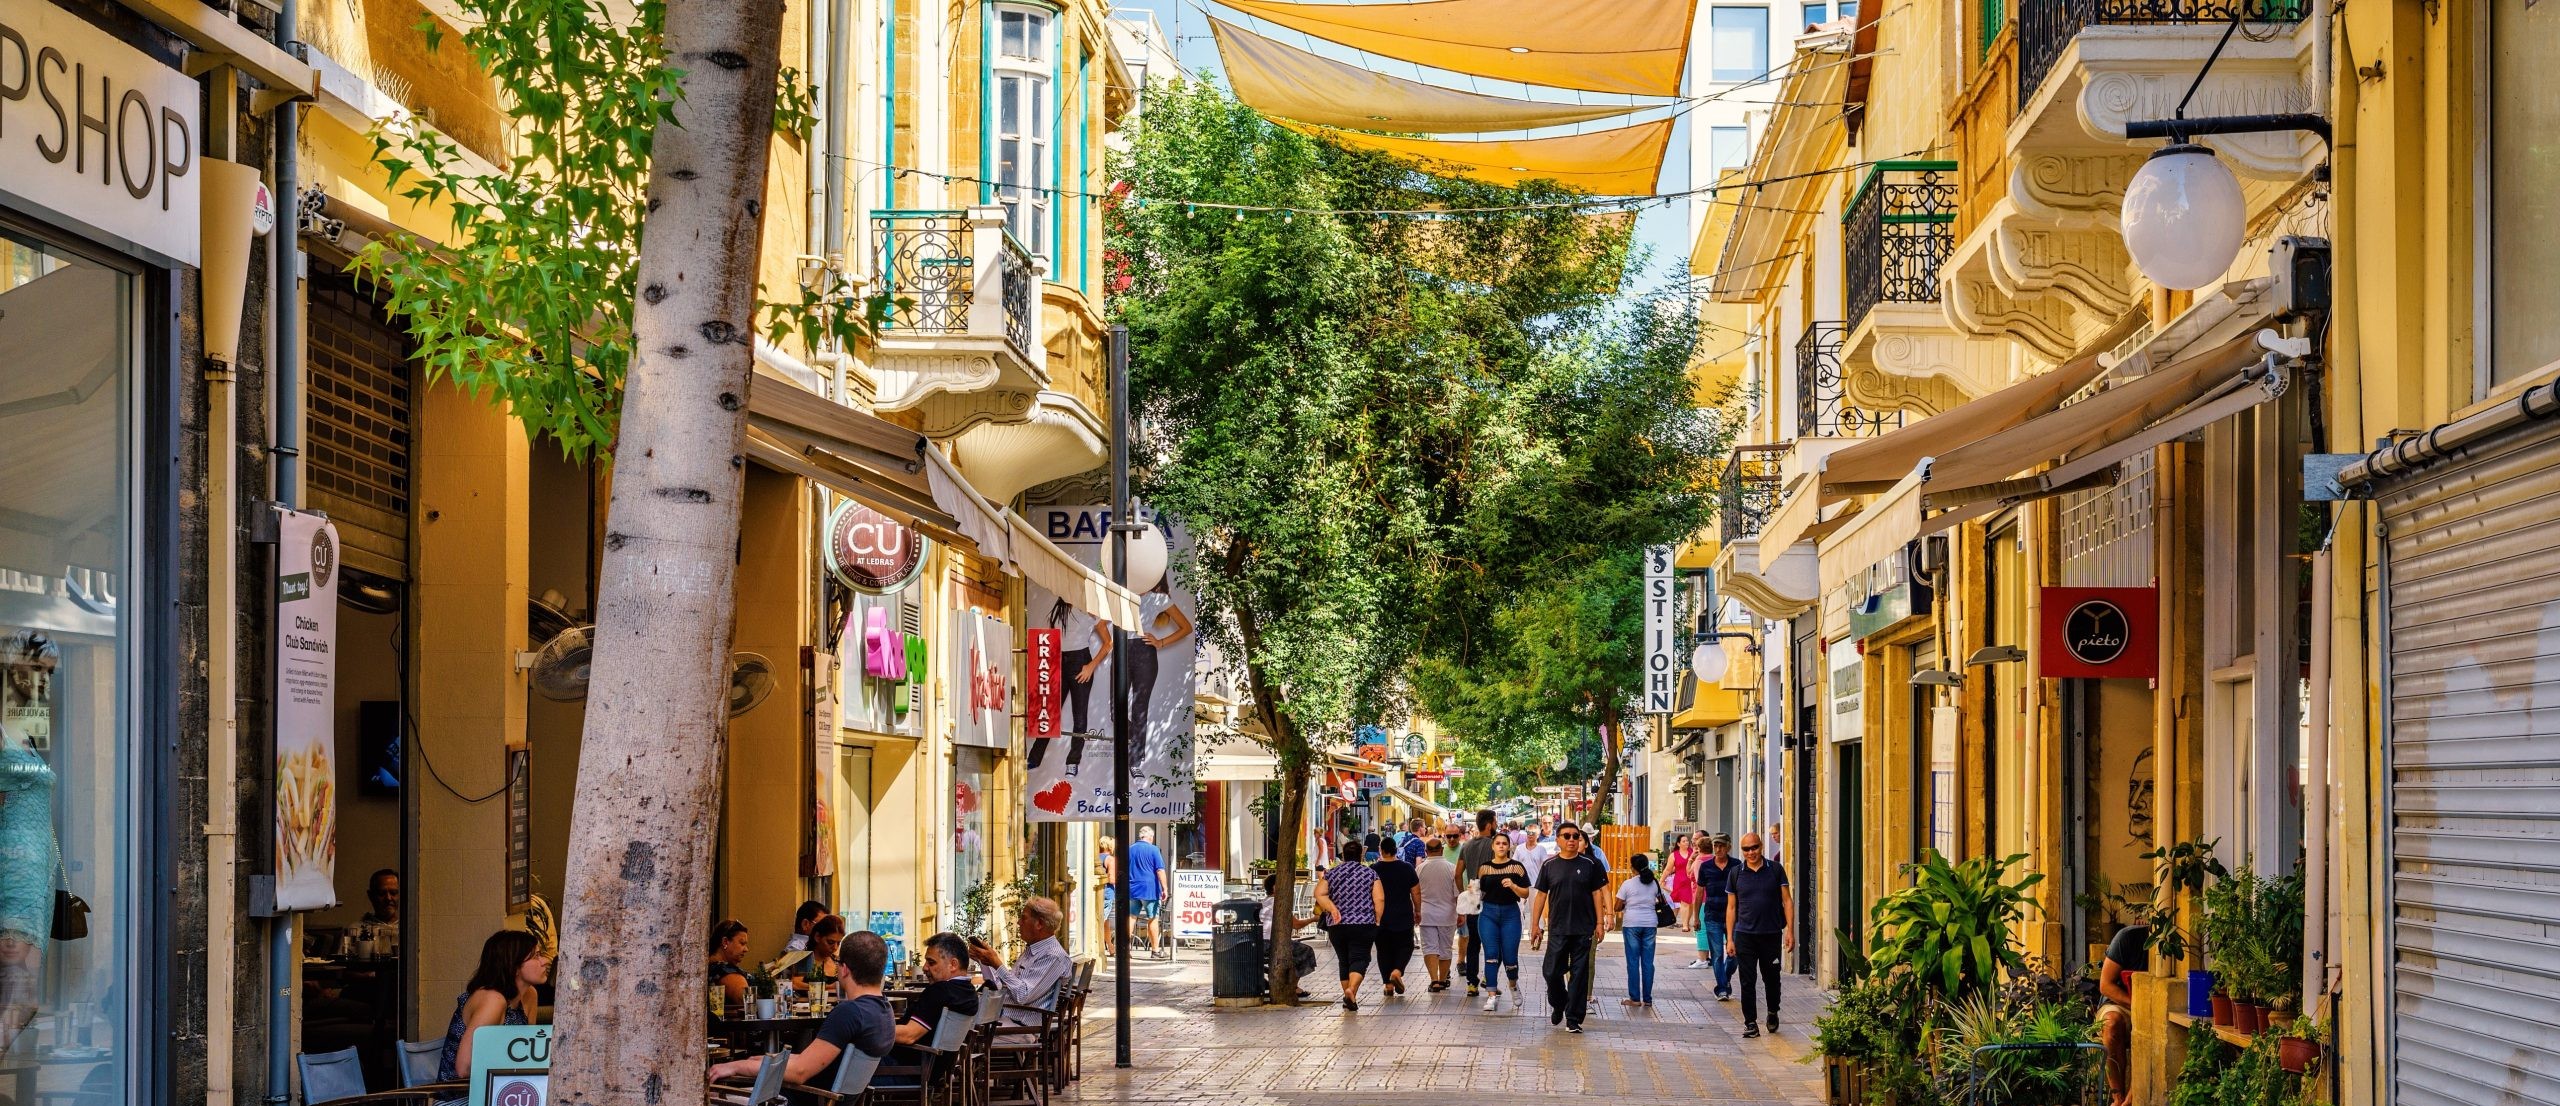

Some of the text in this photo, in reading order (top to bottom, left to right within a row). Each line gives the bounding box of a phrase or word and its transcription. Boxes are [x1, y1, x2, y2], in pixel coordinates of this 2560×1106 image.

[0, 22, 191, 211] PSHOP
[857, 557, 895, 566] AT LEDRAS
[837, 557, 861, 583] MEETING
[869, 575, 896, 588] COFFEE
[896, 561, 915, 580] PLACE
[295, 615, 319, 633] Chicken
[285, 634, 329, 654] Club Sandwich
[2077, 633, 2120, 653] pieto
[1037, 633, 1051, 733] KRASHIAS
[1094, 787, 1114, 797] Bac
[1137, 788, 1169, 799] School
[1077, 799, 1113, 814] Back
[1688, 786, 1697, 821] bamboo
[1178, 874, 1219, 882] METAXA
[1178, 882, 1203, 890] Discount
[1188, 890, 1207, 899] ALL
